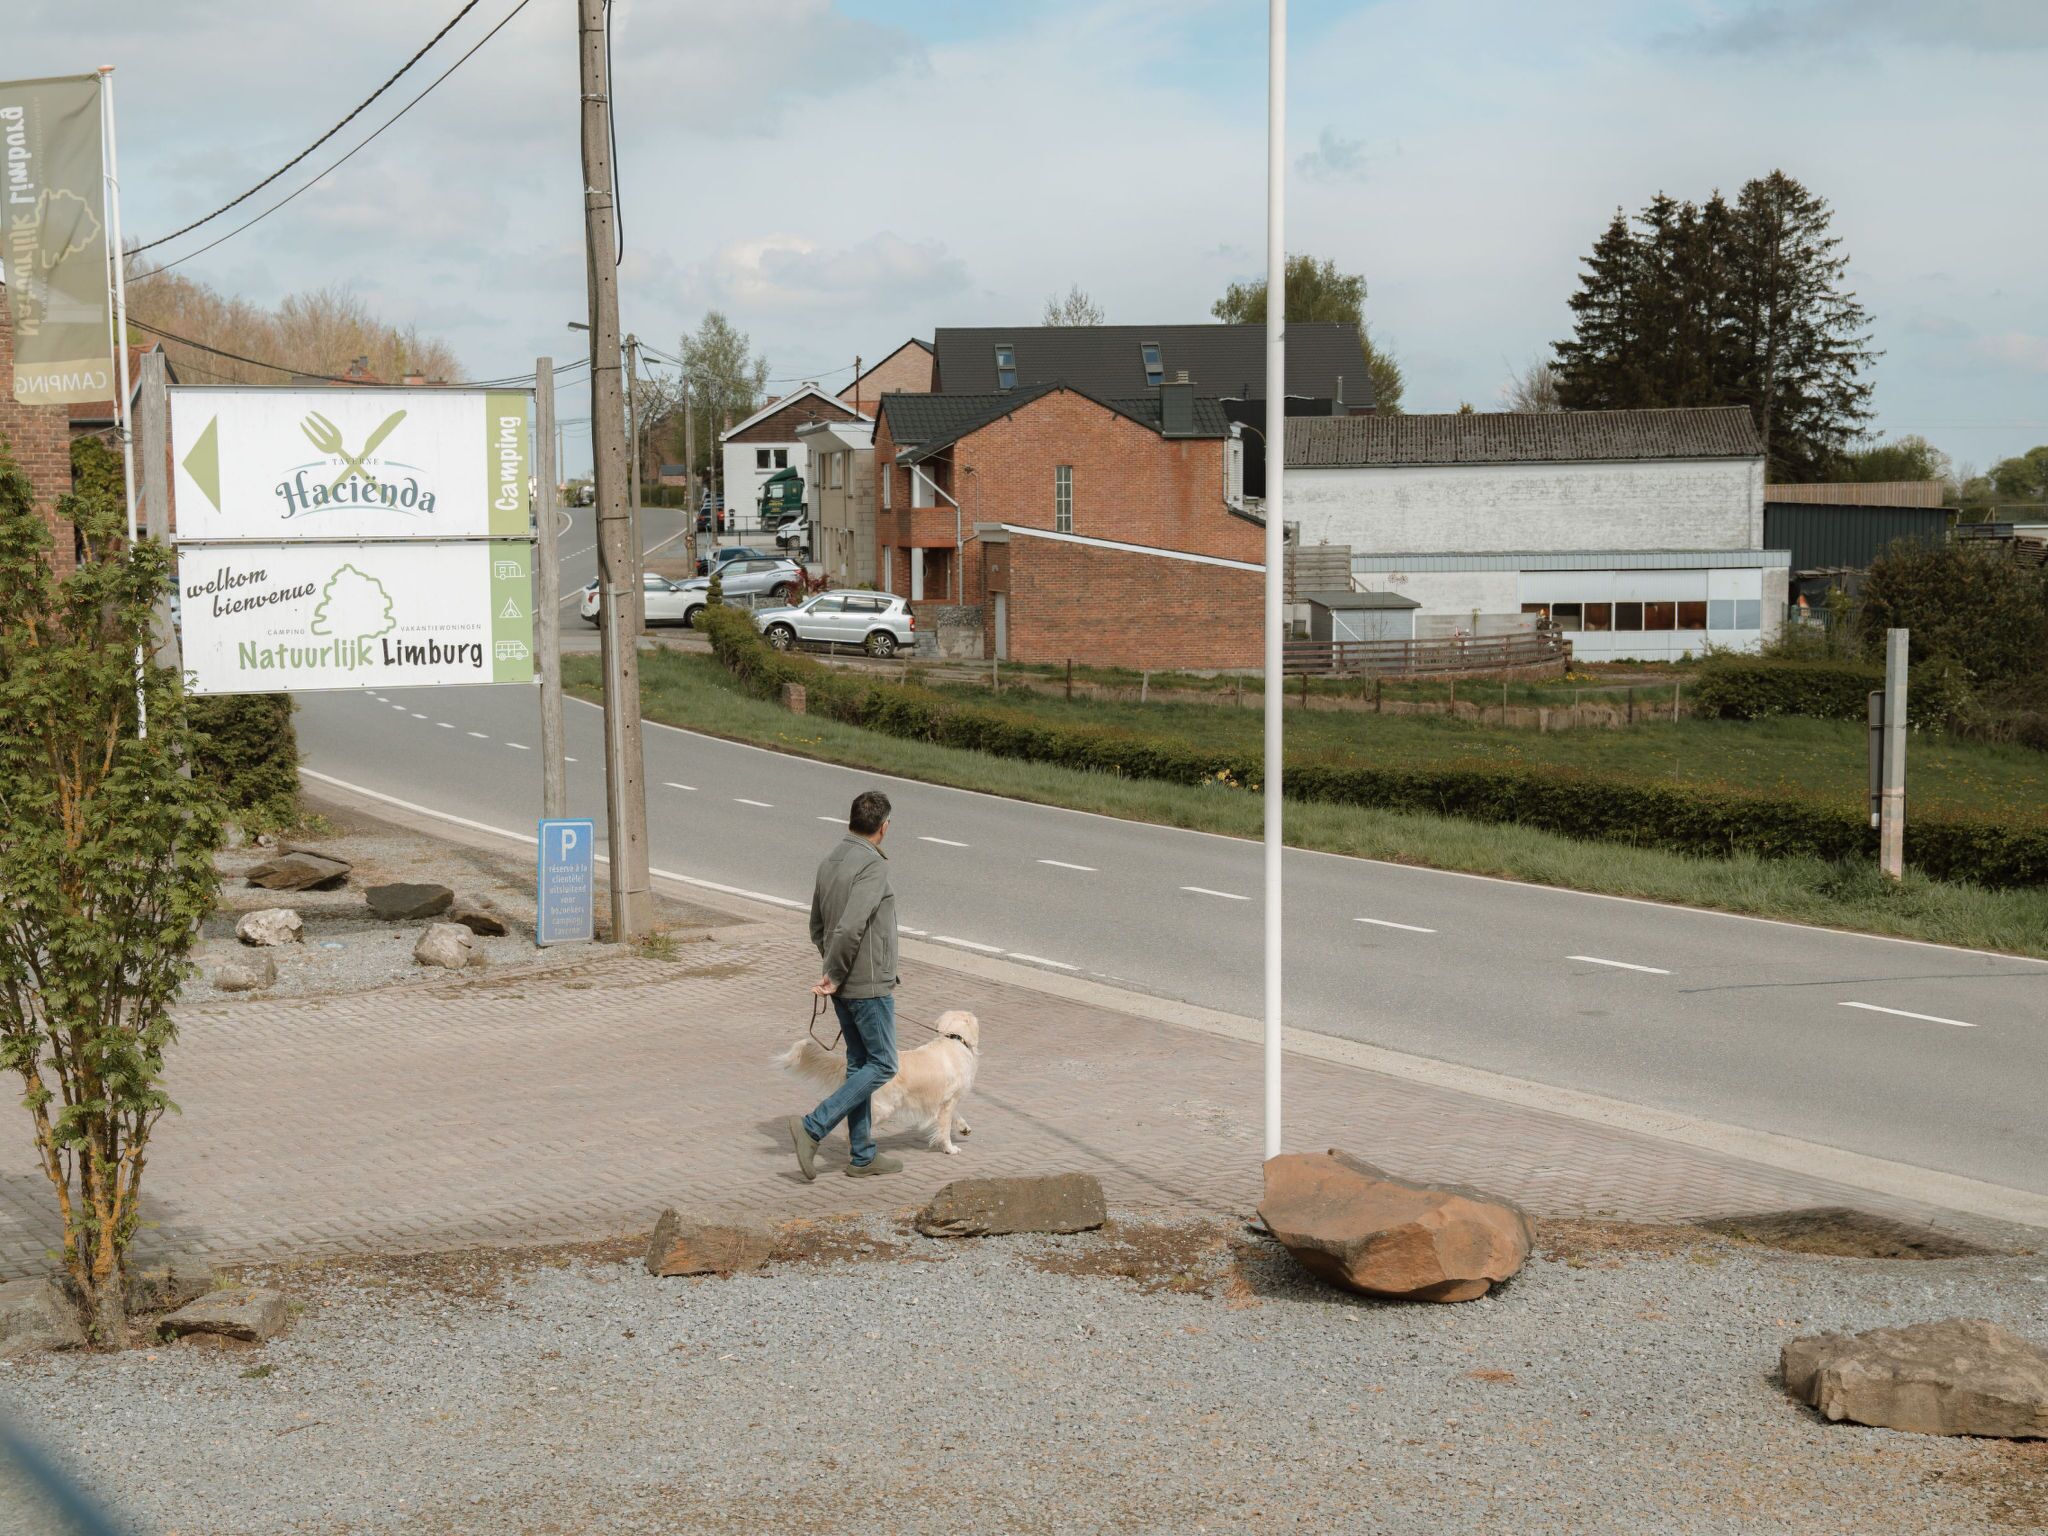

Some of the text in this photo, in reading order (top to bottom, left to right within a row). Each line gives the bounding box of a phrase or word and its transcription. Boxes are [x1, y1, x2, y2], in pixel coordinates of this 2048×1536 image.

[495, 416, 521, 512] Camping
[275, 470, 436, 519] Haciënda
[187, 566, 268, 599] welkom
[212, 582, 316, 618] bienvenue
[400, 624, 482, 632] VAKANTIEWONINGEN
[238, 638, 483, 671] Natuurlijk Limburg
[562, 829, 577, 861] P
